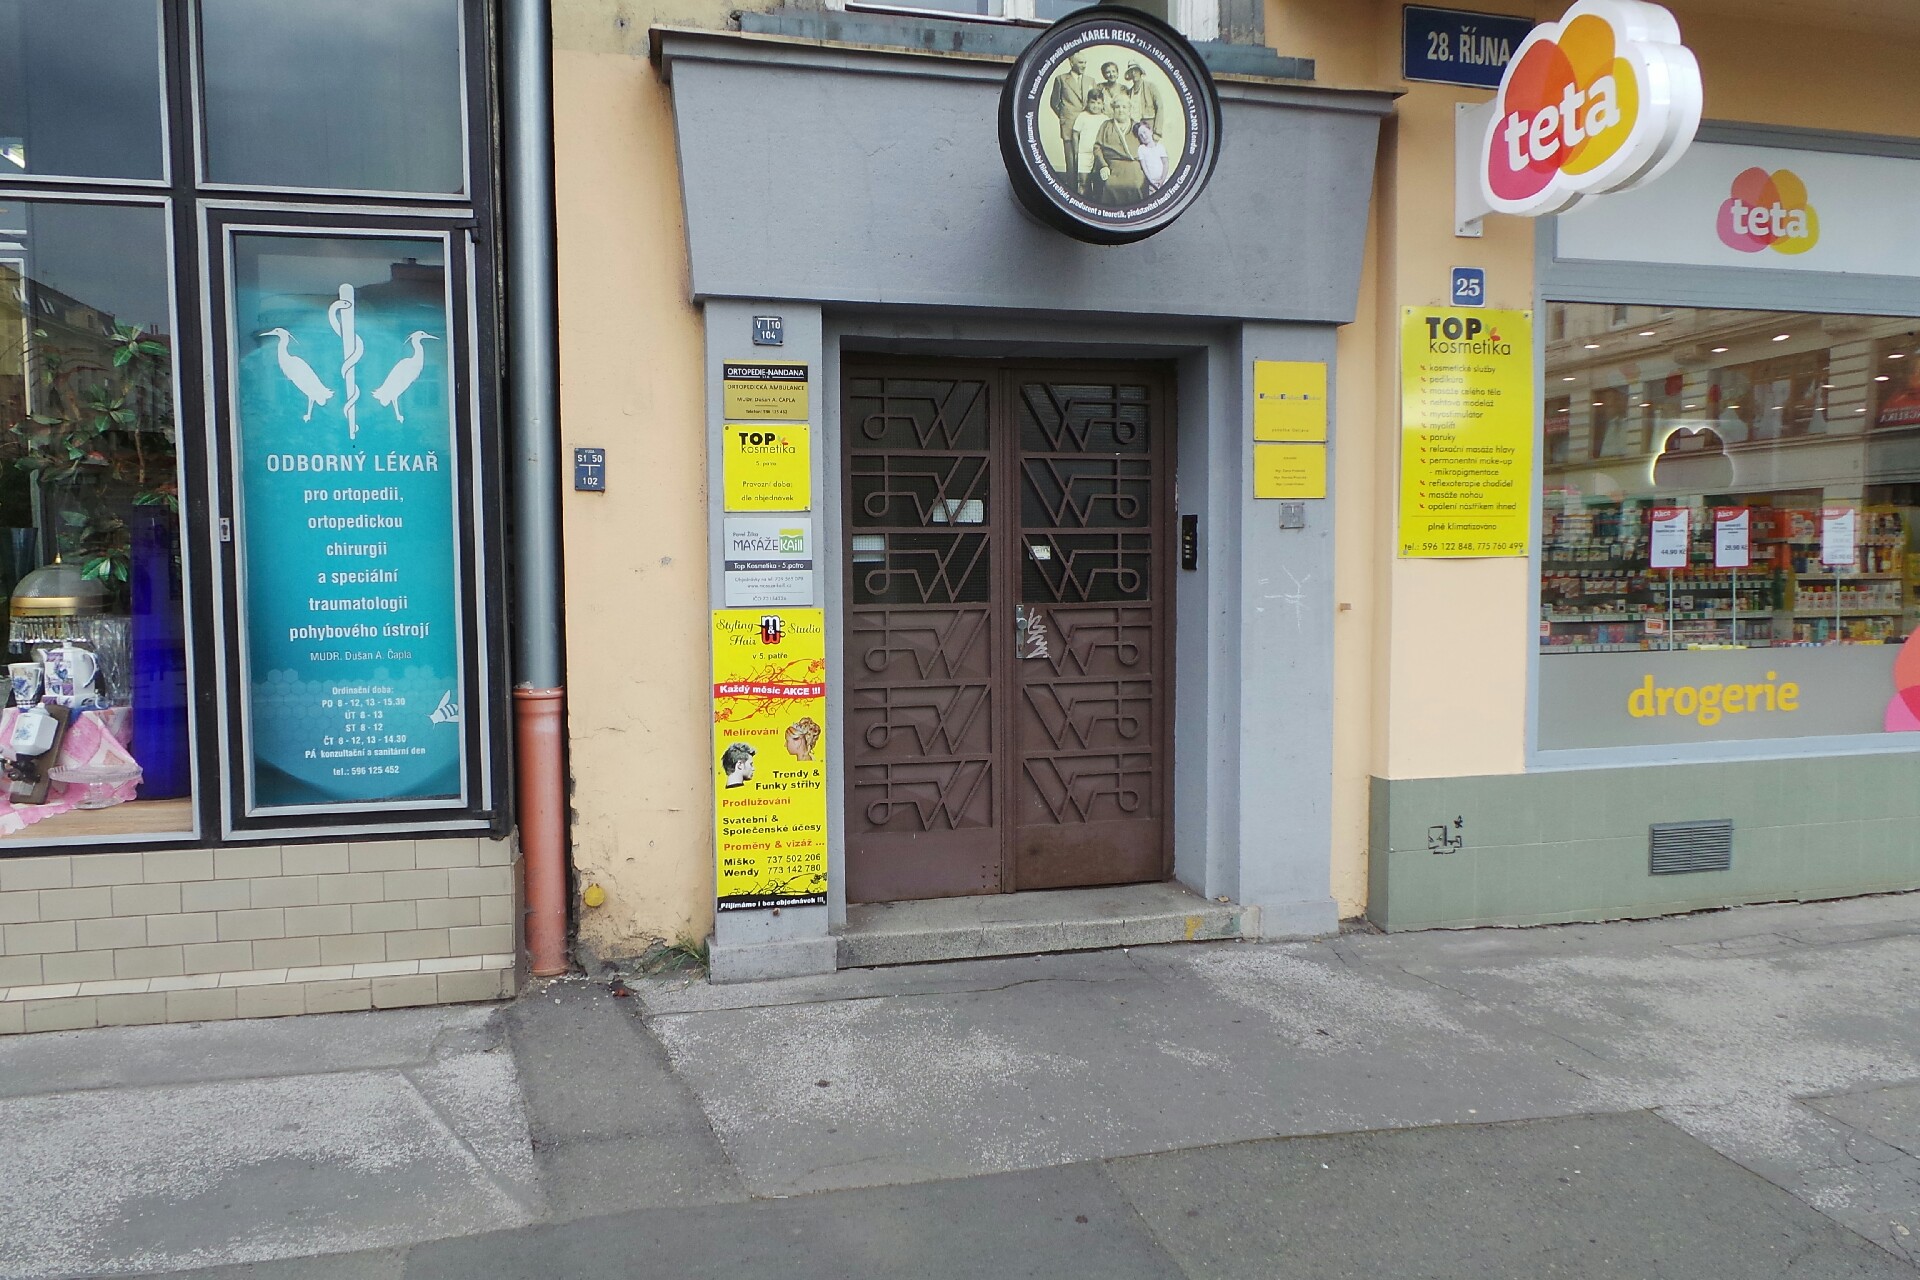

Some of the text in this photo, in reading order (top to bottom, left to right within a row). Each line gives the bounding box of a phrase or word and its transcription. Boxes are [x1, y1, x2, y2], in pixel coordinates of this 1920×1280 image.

[1427, 25, 1511, 66] 28. ŘÍJNA
[1082, 29, 1110, 42] KAREL
[1112, 30, 1136, 44] REISZ
[1174, 70, 1188, 93] Ostrava
[1190, 132, 1198, 154] London
[1504, 75, 1620, 172] teta
[1025, 112, 1036, 144] Významný
[1031, 143, 1044, 164] britský
[1039, 163, 1056, 184] filmový
[1069, 198, 1098, 214] producent
[1169, 182, 1180, 196] Free
[1177, 164, 1192, 184] Cinema
[1730, 199, 1809, 239] teta
[1456, 278, 1480, 296] 25
[1426, 317, 1482, 340] TOP
[762, 330, 776, 340] 104
[1430, 337, 1511, 356] kosmetika
[728, 368, 804, 376] ORTOPEDIE-NANDANA
[1474, 364, 1496, 374] služby
[739, 432, 776, 446] TOP
[1430, 434, 1456, 442] paruky
[742, 444, 796, 454] kosmetika
[1496, 446, 1516, 455] hlavy
[267, 451, 438, 472] ODBORNÝ LÉKAŘ
[592, 454, 602, 462] 50
[1480, 458, 1512, 466] make-up
[1435, 468, 1500, 477] mikropigmentace
[1428, 479, 1480, 488] reflexoterapie
[304, 487, 404, 504] pro ortopedii,
[1496, 502, 1516, 510] ihned
[308, 514, 403, 530] ortopedickou
[1428, 522, 1446, 532] plně
[734, 537, 778, 551] MASÁŽE
[1422, 542, 1438, 550] 596
[1441, 542, 1456, 550] 122
[326, 542, 388, 558] chirurgii
[318, 568, 398, 586] a speciální
[308, 596, 408, 612] traumatologii
[289, 622, 430, 642] pohybového ústrojí
[716, 619, 820, 646] Styling Hair Studio
[310, 650, 412, 661] MUDR. Dušan A. Čapla
[332, 686, 394, 695] Ordinační doba:
[720, 685, 750, 694] Každý
[752, 686, 780, 694] měsíc
[322, 698, 406, 708] PO 12, 13 15.30
[1627, 671, 1799, 726] drogerie
[344, 710, 356, 720] ÚT
[346, 723, 384, 732] ST 12
[324, 736, 334, 746] ČT
[352, 736, 364, 745] 12,
[384, 735, 406, 743] 14.30
[305, 748, 316, 758] PÁ
[320, 748, 365, 758] konzultační
[374, 747, 408, 756] sanitární
[411, 747, 426, 755] den
[773, 770, 808, 779] Trendy
[756, 780, 820, 791] Funky střihy
[722, 797, 791, 807] Prodlužování
[723, 816, 767, 824] Svatební
[723, 824, 822, 836] Společenské účesy
[724, 840, 812, 851] Proměny & vizáž
[724, 854, 820, 866] Miško 737 502 206
[724, 868, 759, 878] Wendy
[768, 866, 784, 874] 773
[788, 866, 802, 874] 142
